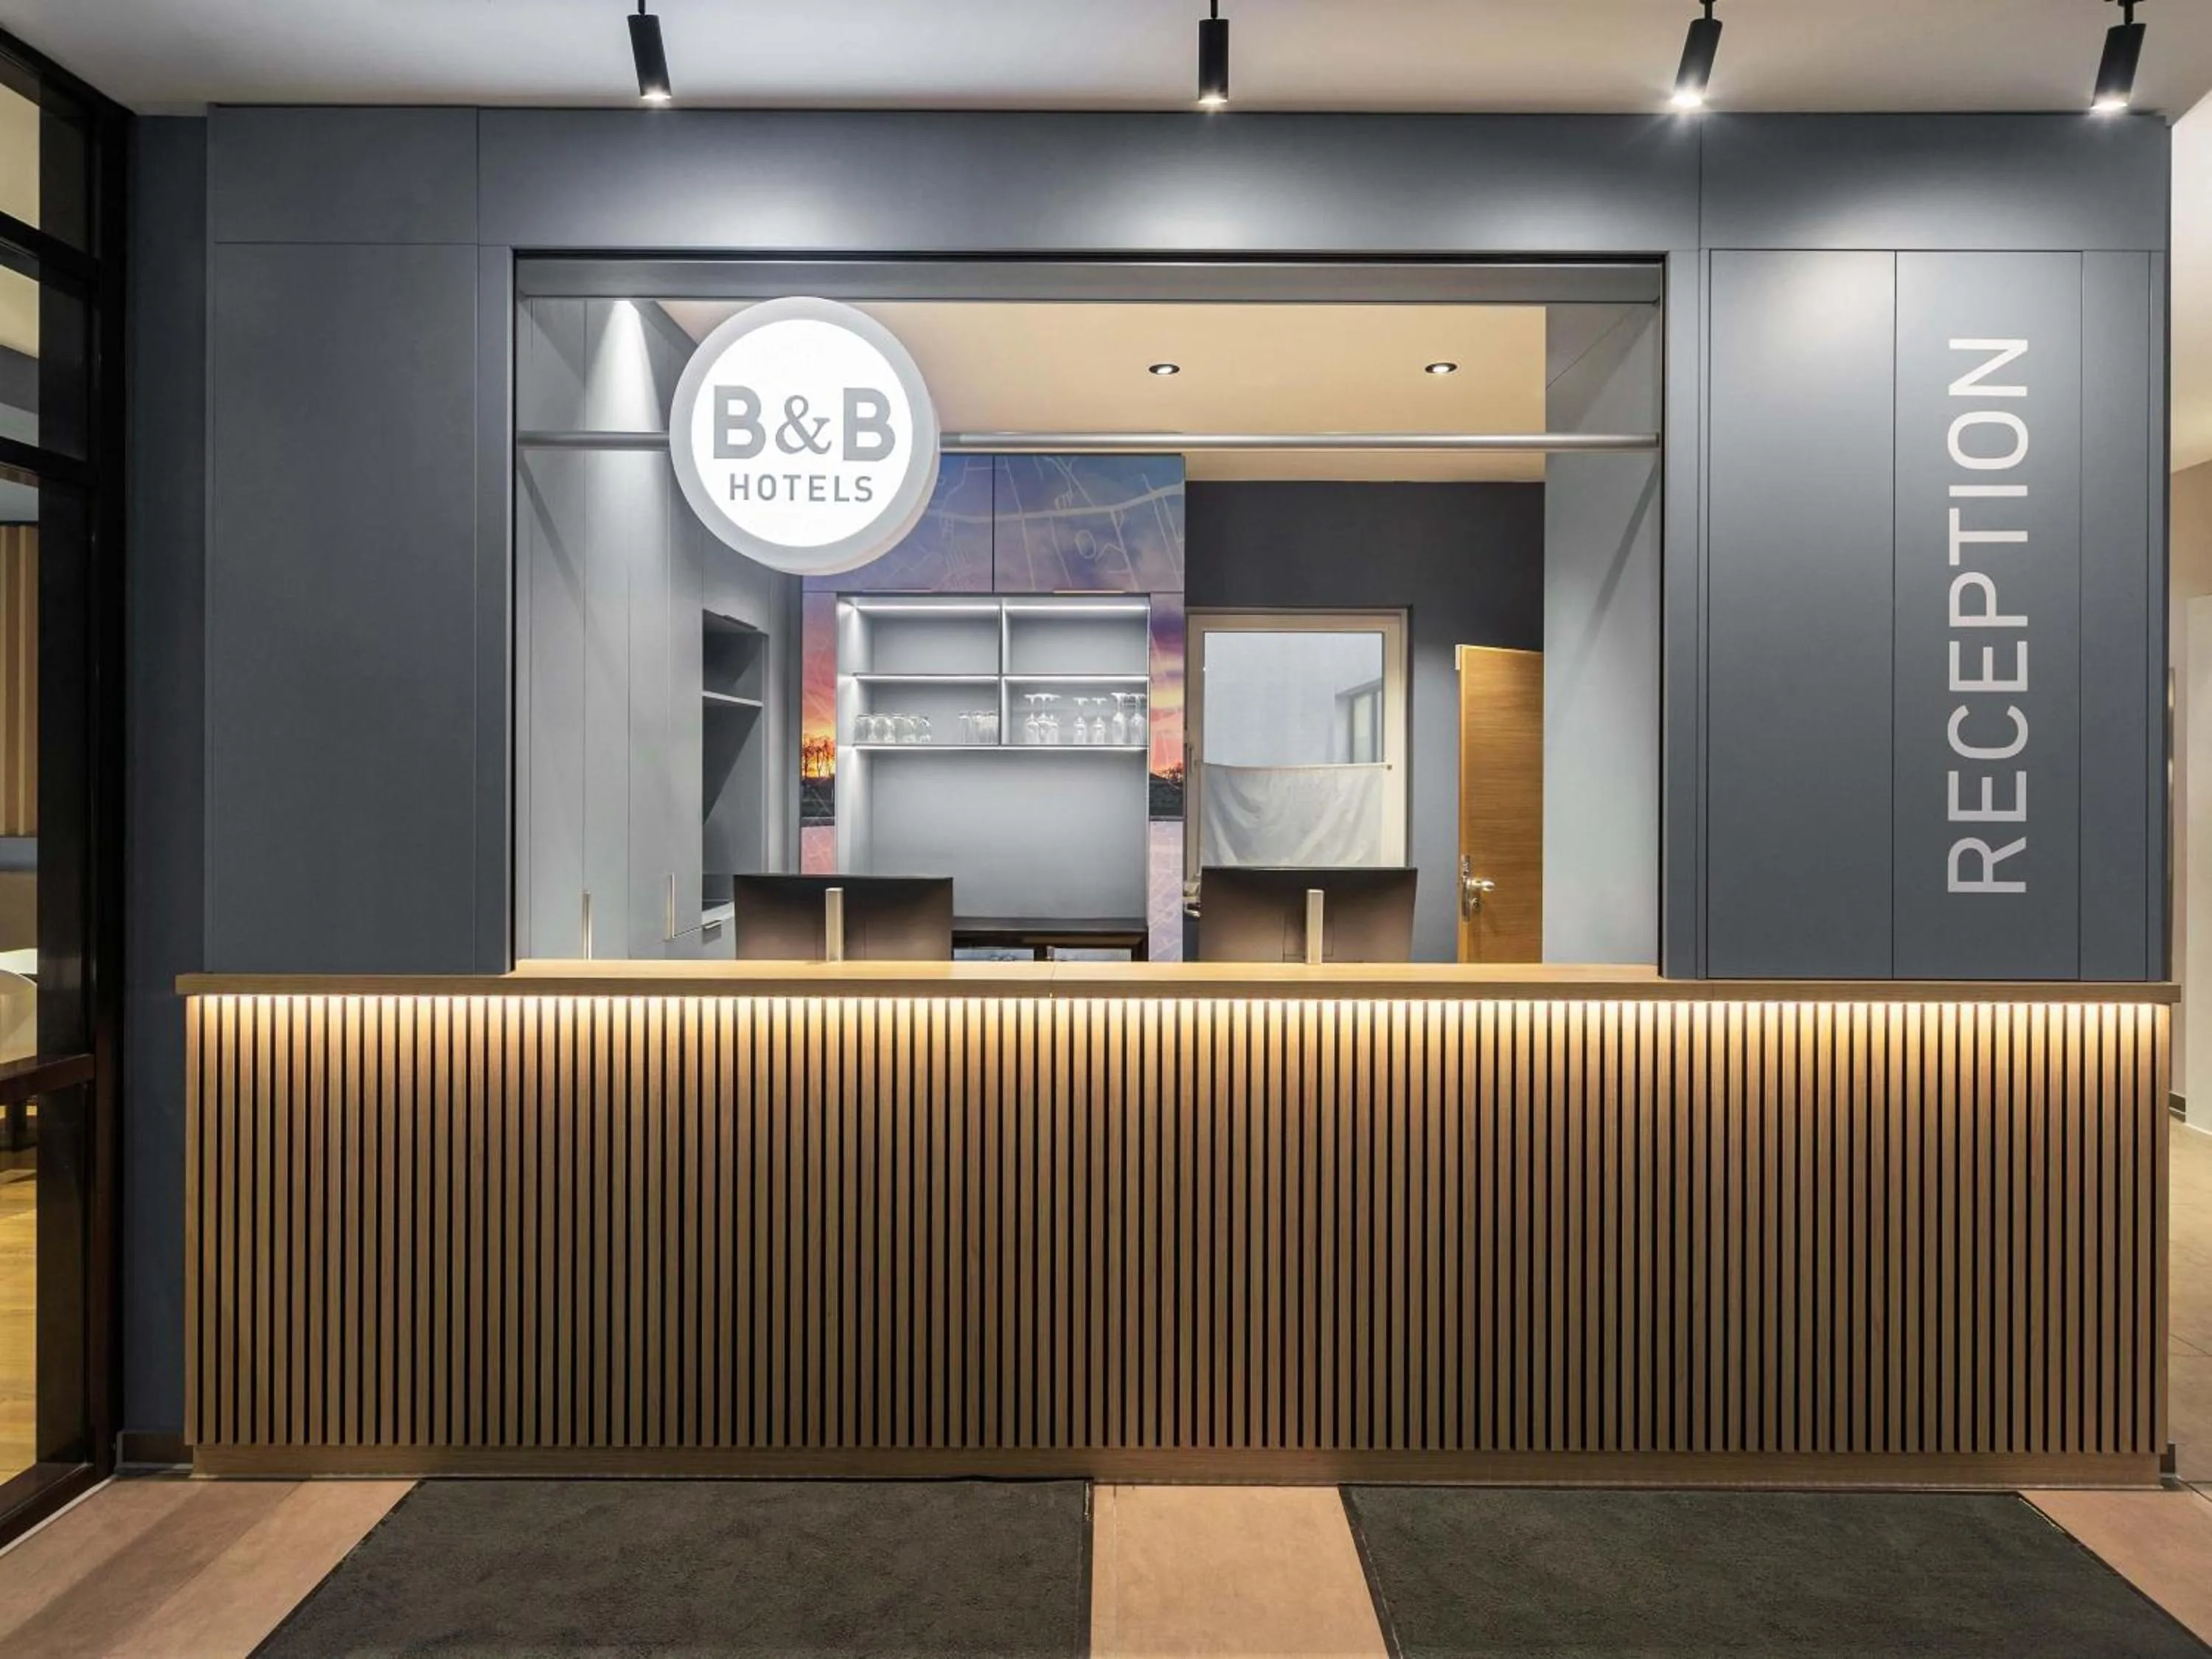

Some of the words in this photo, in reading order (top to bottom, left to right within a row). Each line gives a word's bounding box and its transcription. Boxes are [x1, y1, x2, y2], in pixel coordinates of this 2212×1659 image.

[713, 385, 896, 462] B&B
[728, 473, 873, 503] HOTELS
[1947, 338, 2029, 893] RECEPTION
